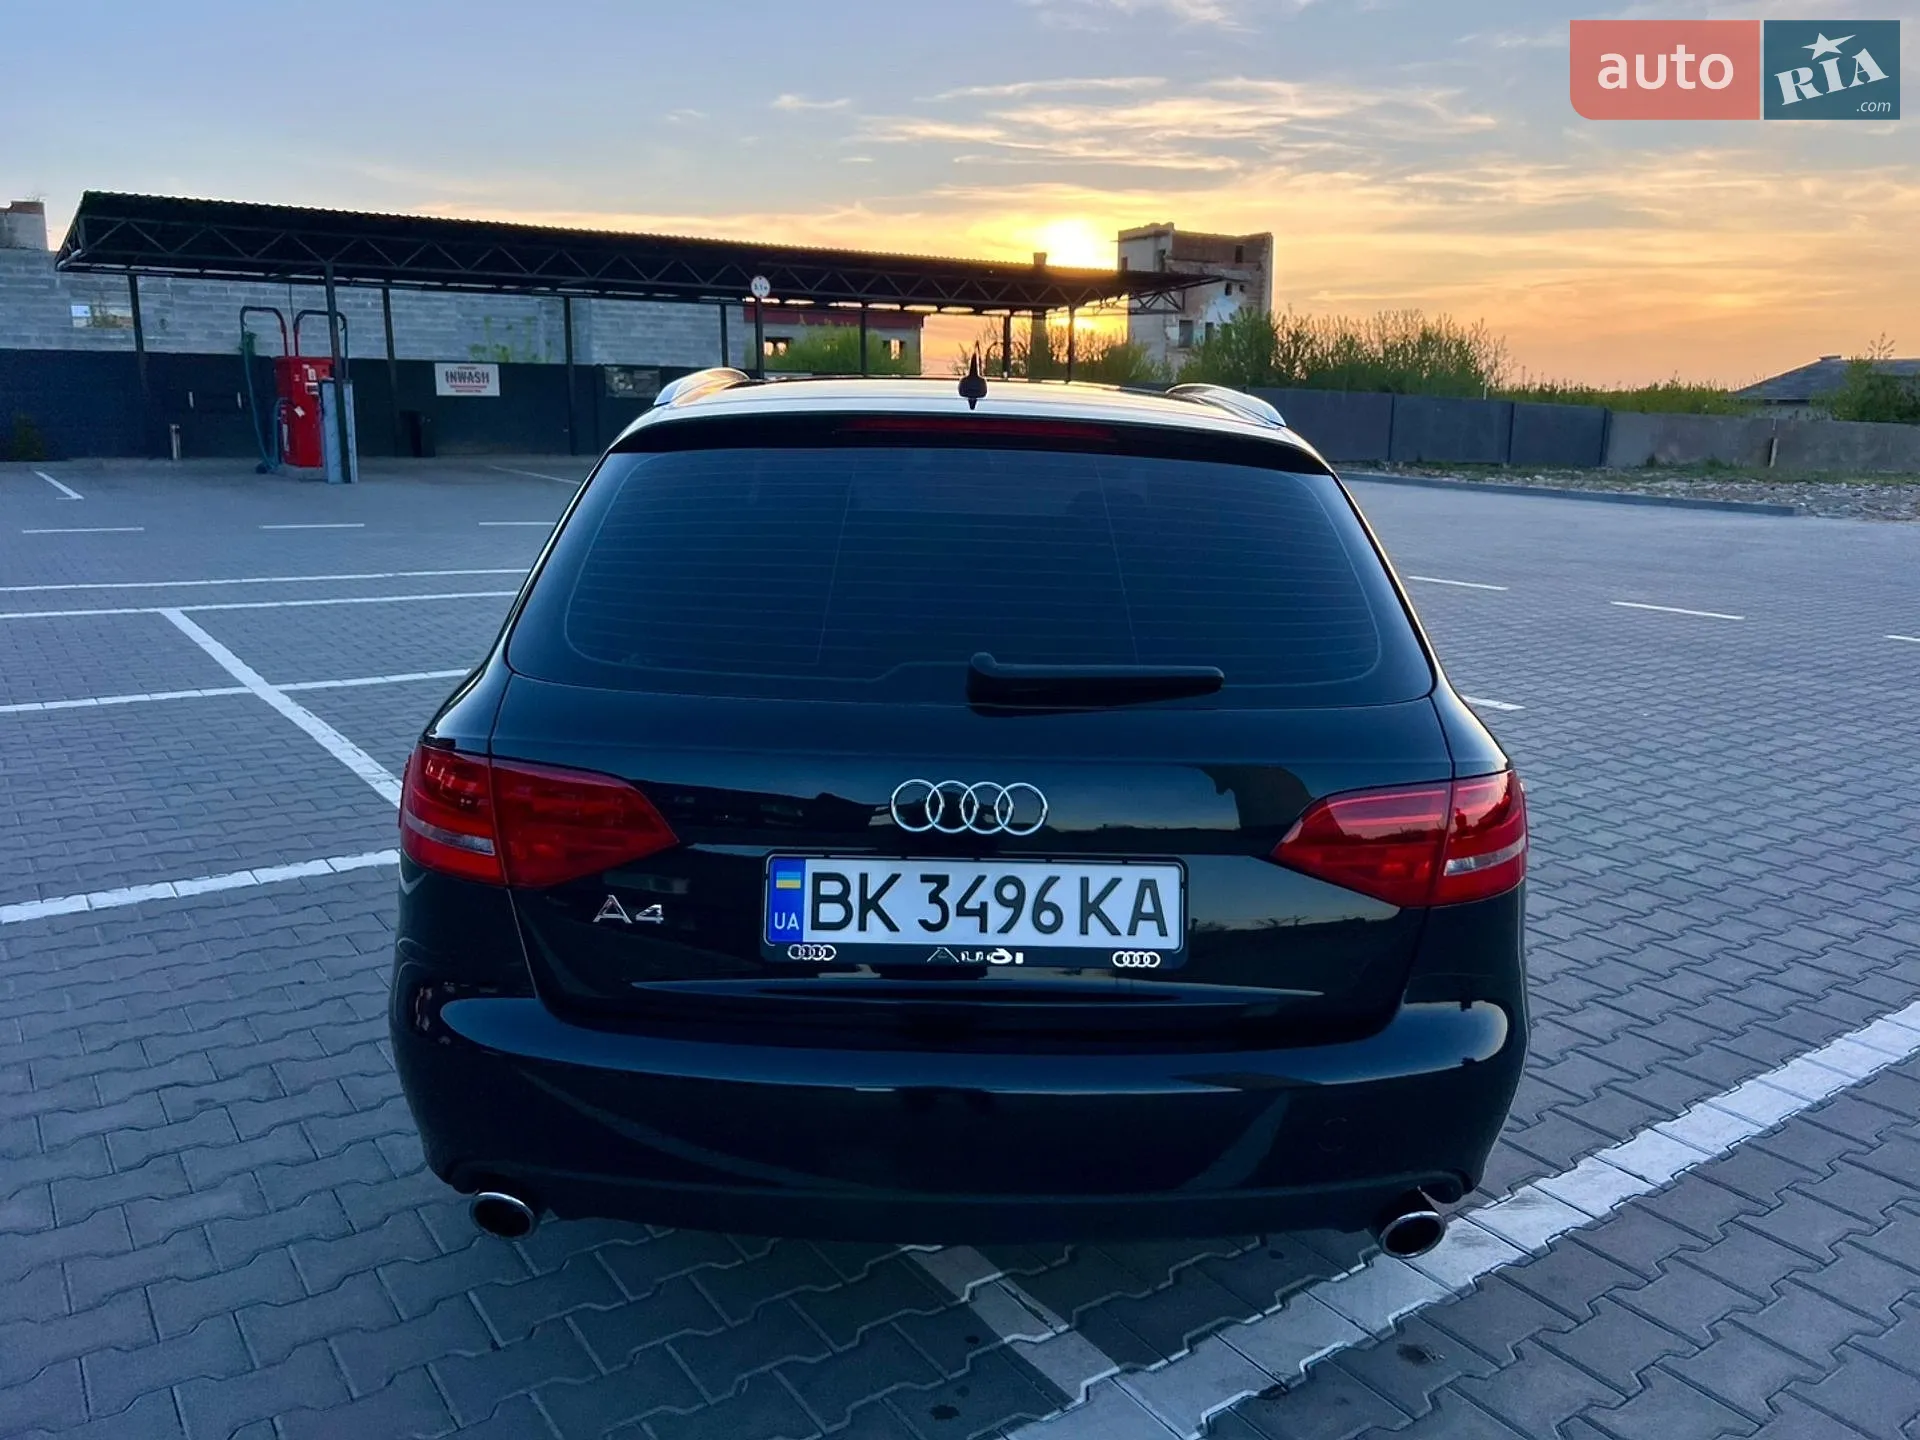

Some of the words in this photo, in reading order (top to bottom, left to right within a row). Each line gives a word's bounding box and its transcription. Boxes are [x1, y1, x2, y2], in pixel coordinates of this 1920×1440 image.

[445, 370, 490, 384] INWASH
[592, 894, 664, 924] A4
[810, 871, 902, 932] BK
[917, 874, 1064, 937] 3496
[1079, 876, 1170, 937] KA
[774, 912, 800, 931] UA
